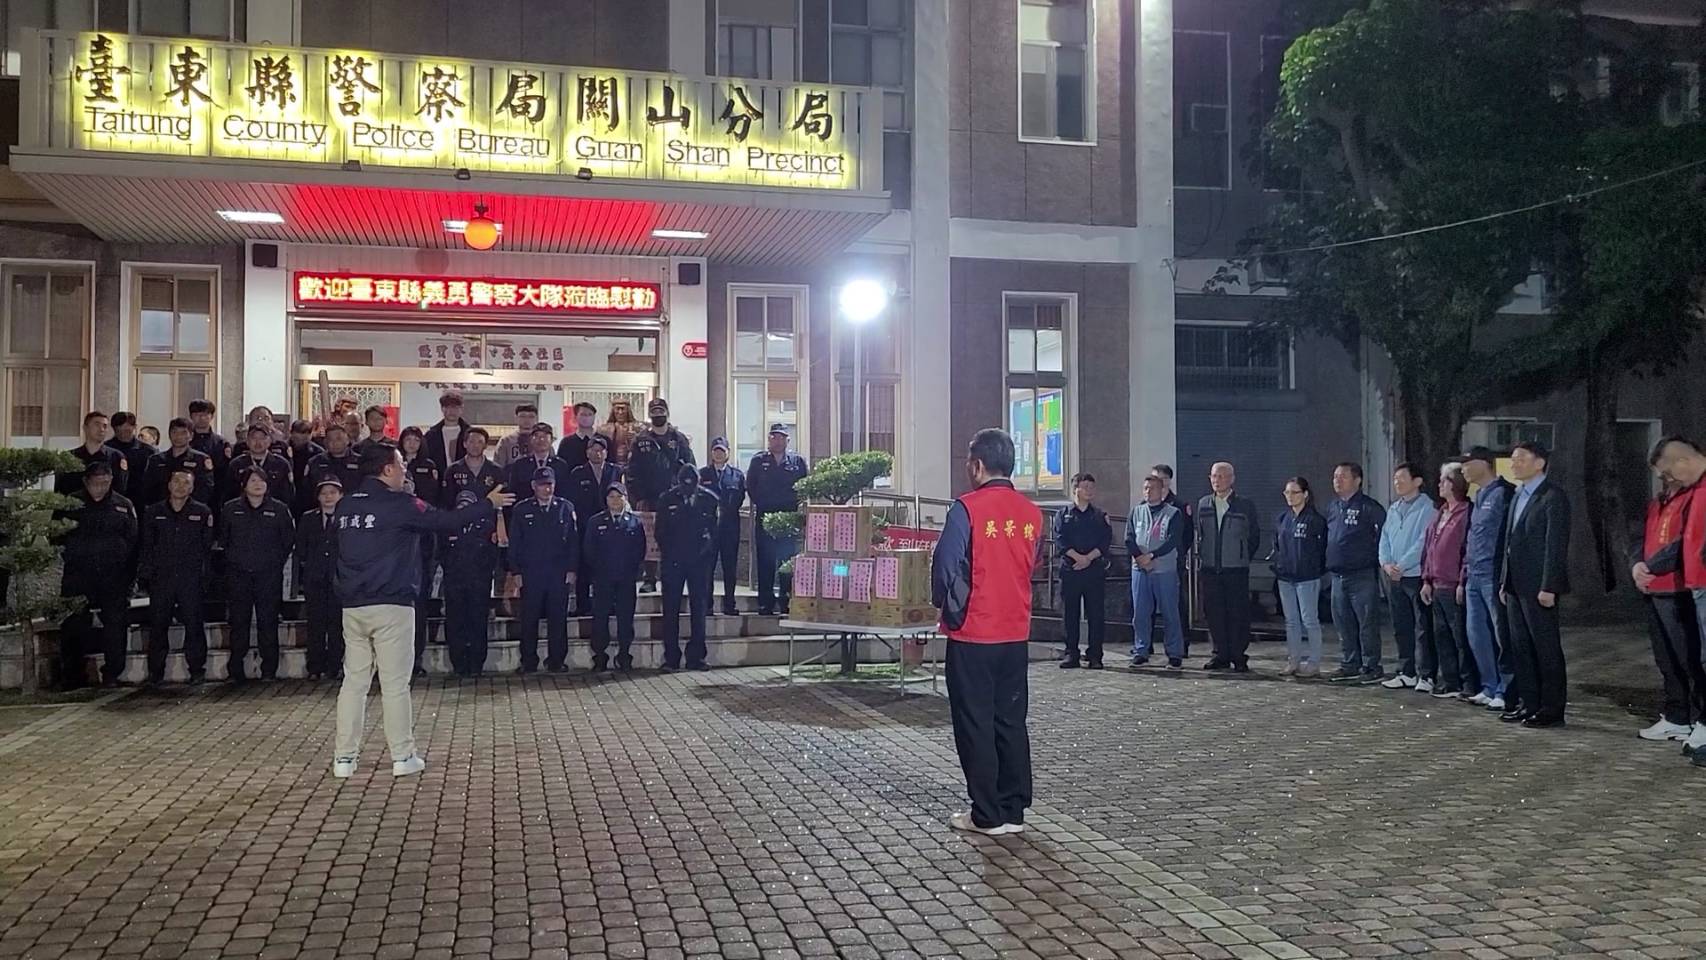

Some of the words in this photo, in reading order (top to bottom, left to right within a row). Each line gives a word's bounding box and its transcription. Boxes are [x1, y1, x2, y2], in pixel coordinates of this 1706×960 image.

[75, 33, 834, 142] 臺東縣警察局關山分局
[84, 106, 192, 141] Taitung
[223, 115, 327, 146] County
[353, 122, 435, 150] Police
[458, 128, 550, 157] Bureau
[575, 136, 644, 162] Guan
[667, 139, 731, 164] Shan
[748, 147, 845, 174] Precinct
